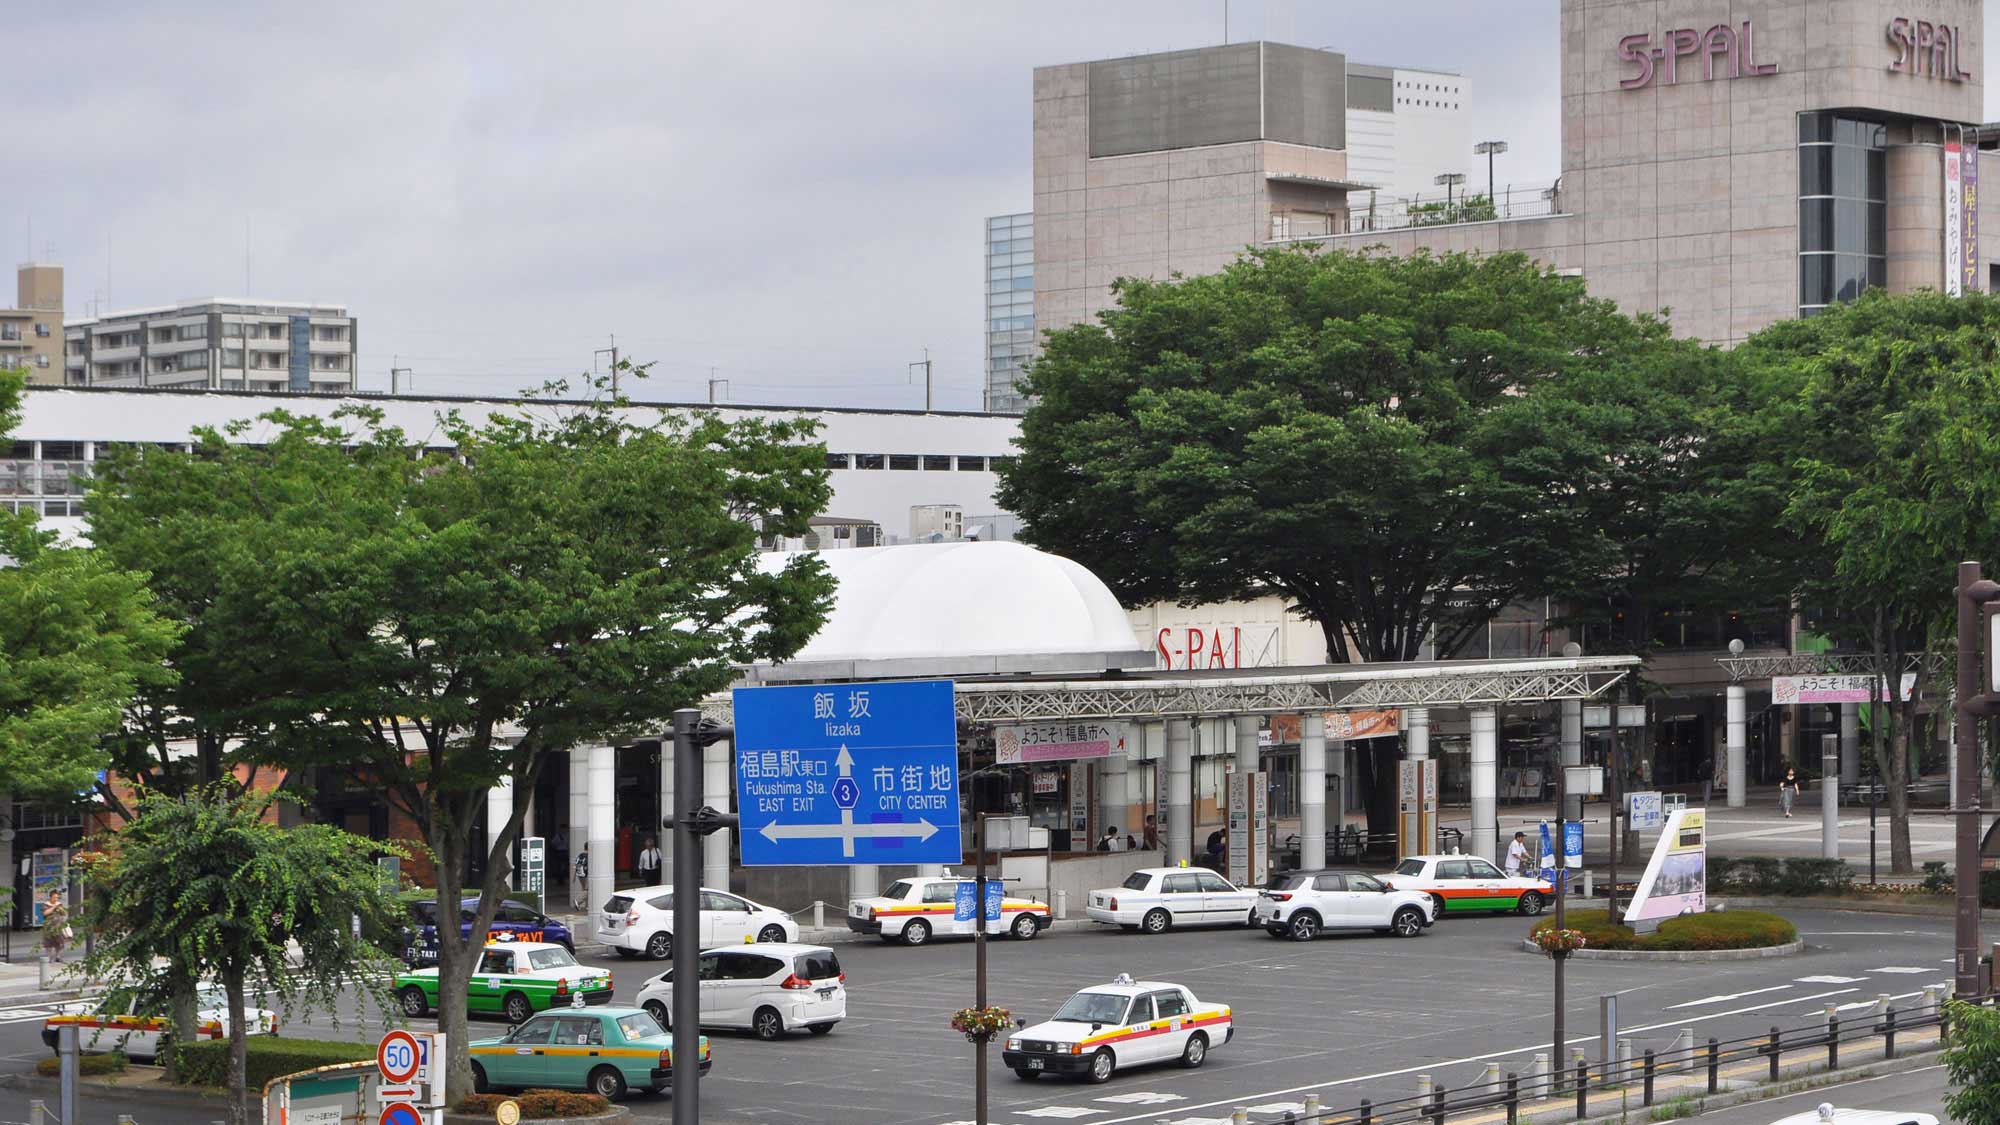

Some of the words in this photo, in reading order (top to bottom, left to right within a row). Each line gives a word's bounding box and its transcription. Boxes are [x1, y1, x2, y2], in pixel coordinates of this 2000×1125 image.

[1618, 20, 1779, 89] S-PAL
[1888, 16, 1972, 82] S-PAL
[813, 690, 871, 719] 飯坂
[825, 723, 861, 737] Iizaka
[872, 764, 952, 792] 市街地
[745, 781, 801, 795] Fukushima
[806, 780, 827, 795] Sta.
[841, 785, 850, 801] 3
[759, 798, 784, 812] EAST
[793, 797, 814, 811] EXIT
[879, 796, 901, 810] CITY
[907, 795, 947, 810] CENTER
[421, 950, 438, 958] TAXI
[387, 1045, 410, 1068] 50
